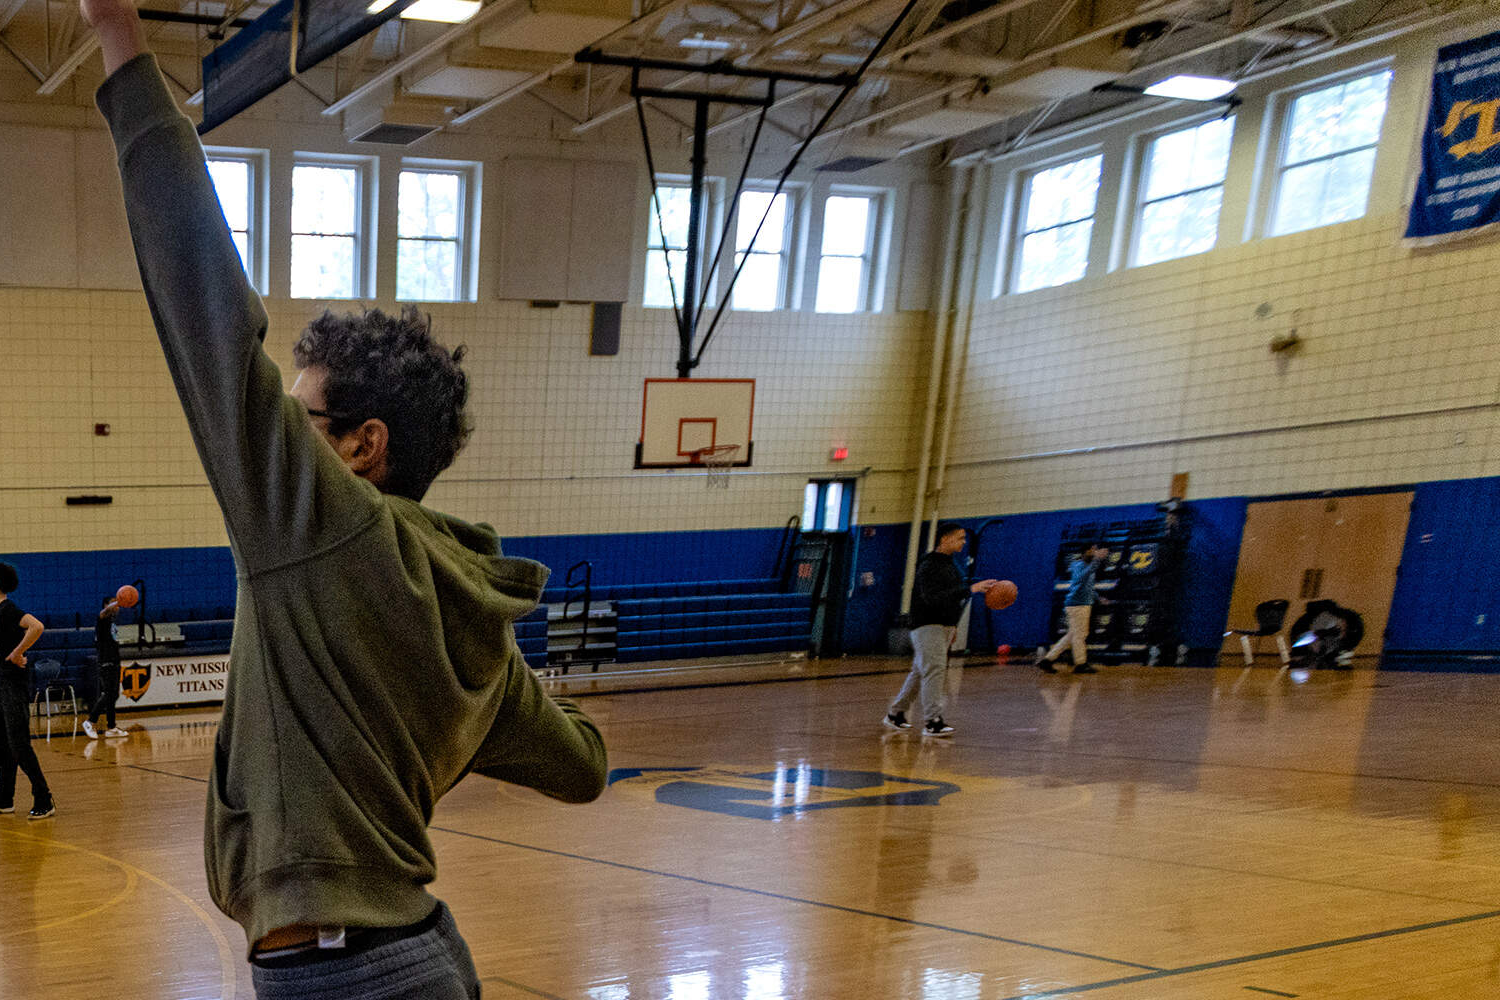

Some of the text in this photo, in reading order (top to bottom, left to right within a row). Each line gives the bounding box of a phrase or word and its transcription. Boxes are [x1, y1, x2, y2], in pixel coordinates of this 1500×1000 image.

[156, 661, 230, 677] NEW MISSI
[177, 679, 225, 693] TITANS
